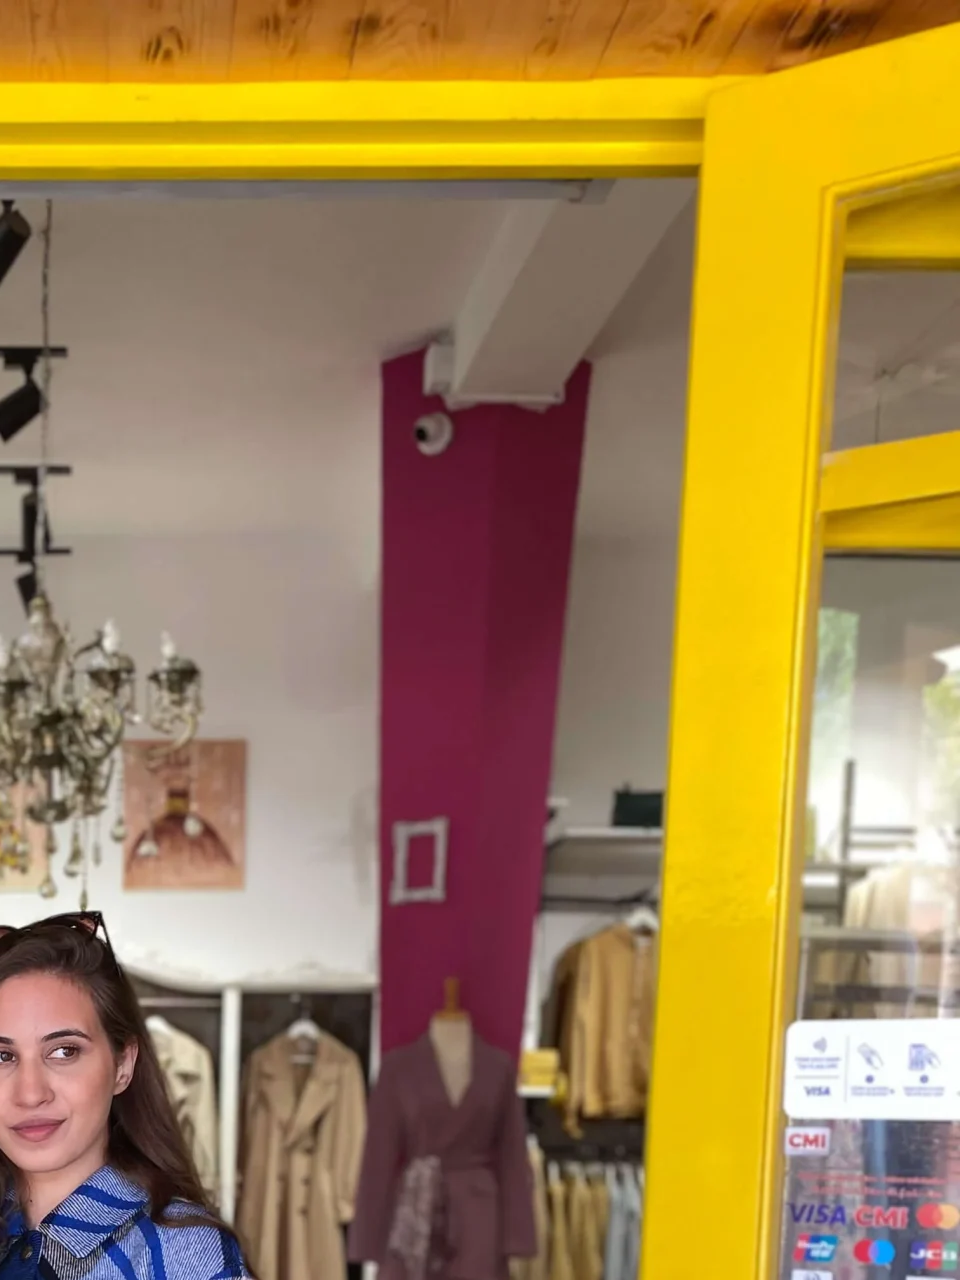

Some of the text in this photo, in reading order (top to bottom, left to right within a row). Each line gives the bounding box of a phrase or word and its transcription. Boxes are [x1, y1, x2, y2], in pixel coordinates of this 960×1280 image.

[804, 1086, 831, 1097] VISA
[788, 1134, 827, 1149] CMI
[790, 1204, 909, 1229] VISA CMI
[910, 1249, 957, 1260] JCB
